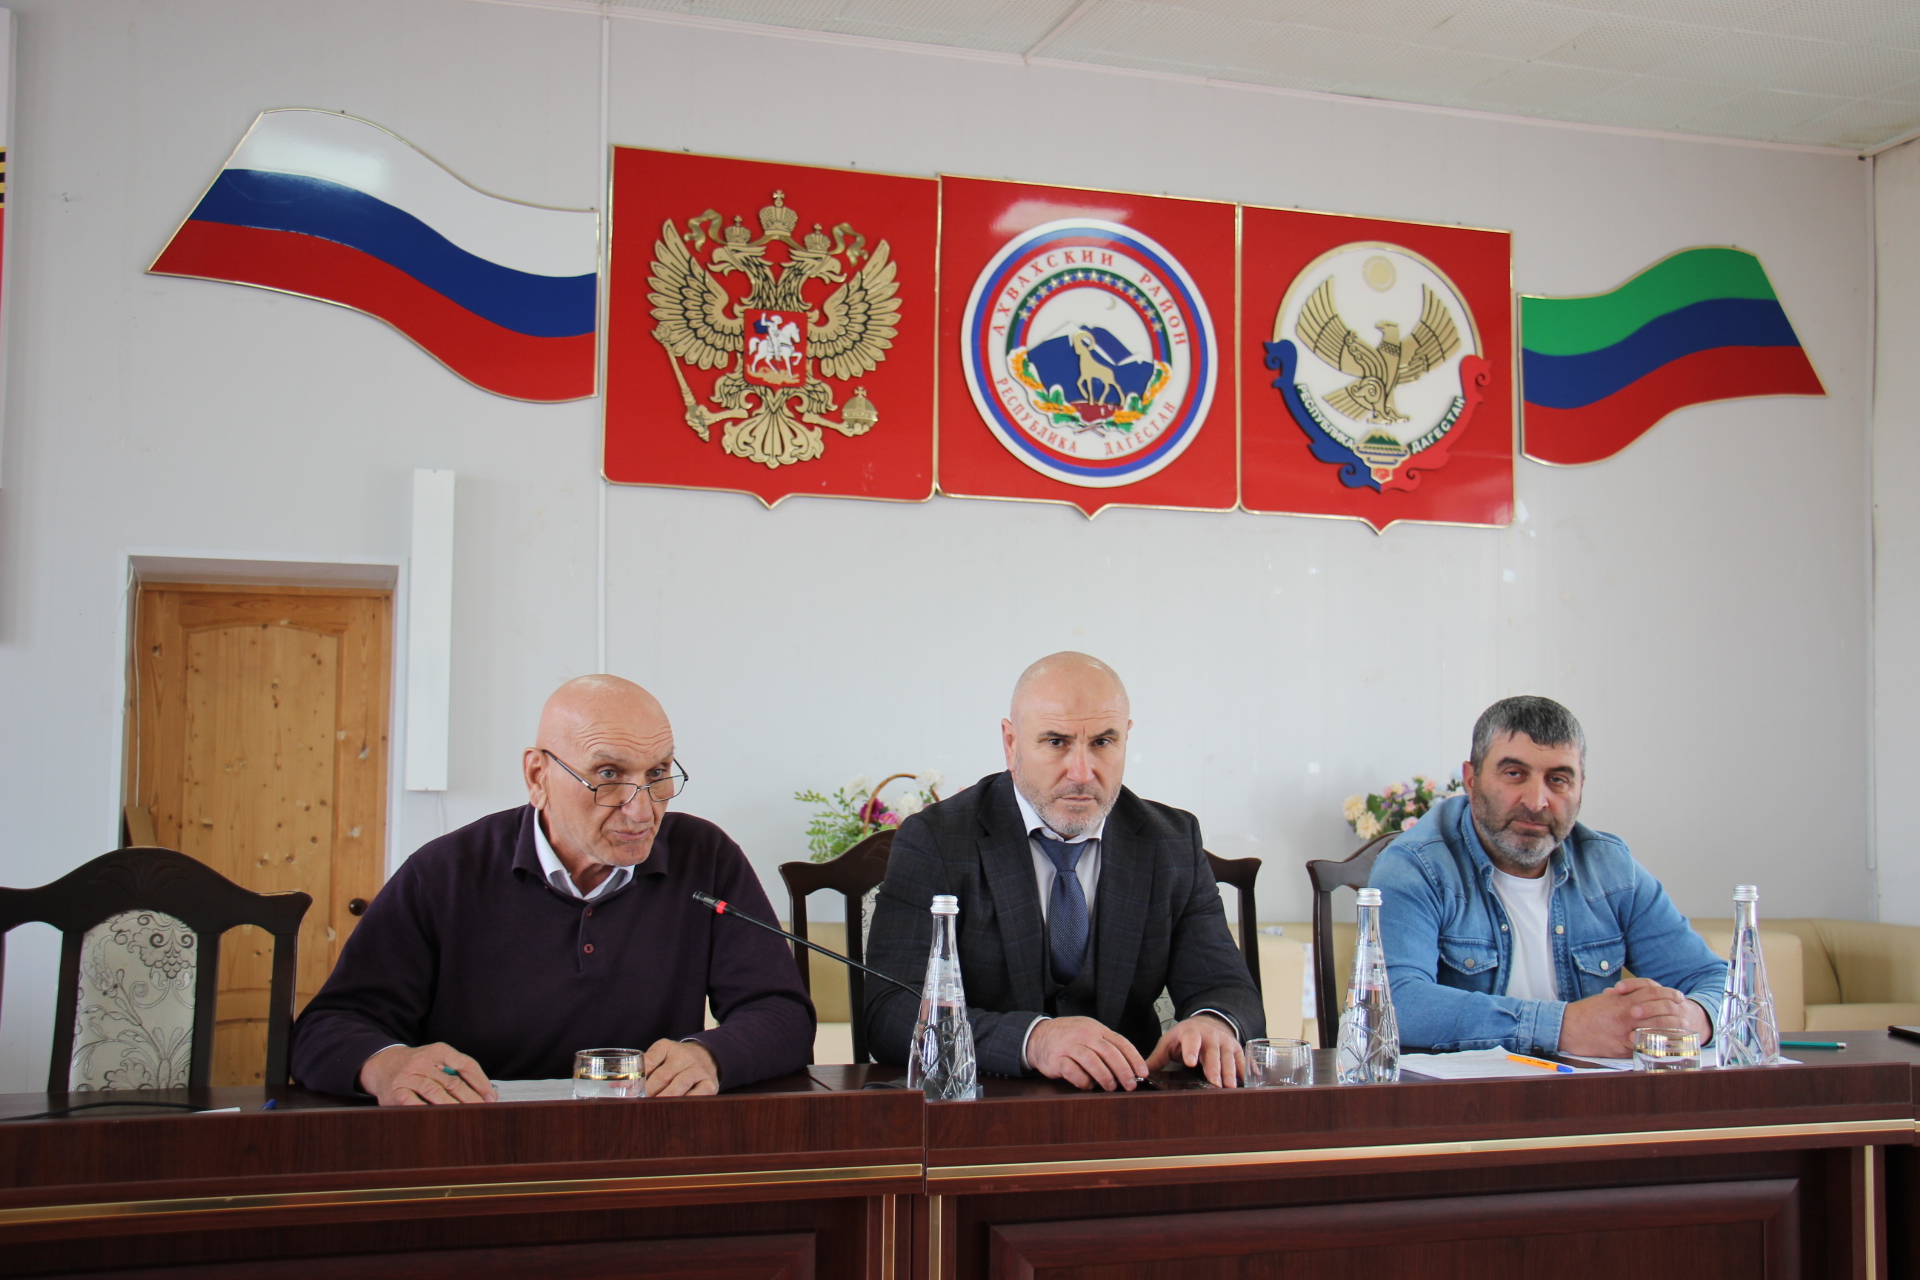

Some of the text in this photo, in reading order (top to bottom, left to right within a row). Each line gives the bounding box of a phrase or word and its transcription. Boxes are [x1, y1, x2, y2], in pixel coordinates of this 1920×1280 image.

[1139, 272, 1188, 346] РАЙОН
[997, 378, 1176, 456] РЕСПУБЛИКА ДАГЕСТАН
[1297, 384, 1467, 454] РЕСПУБЛИКА ДАГЕСТАН
